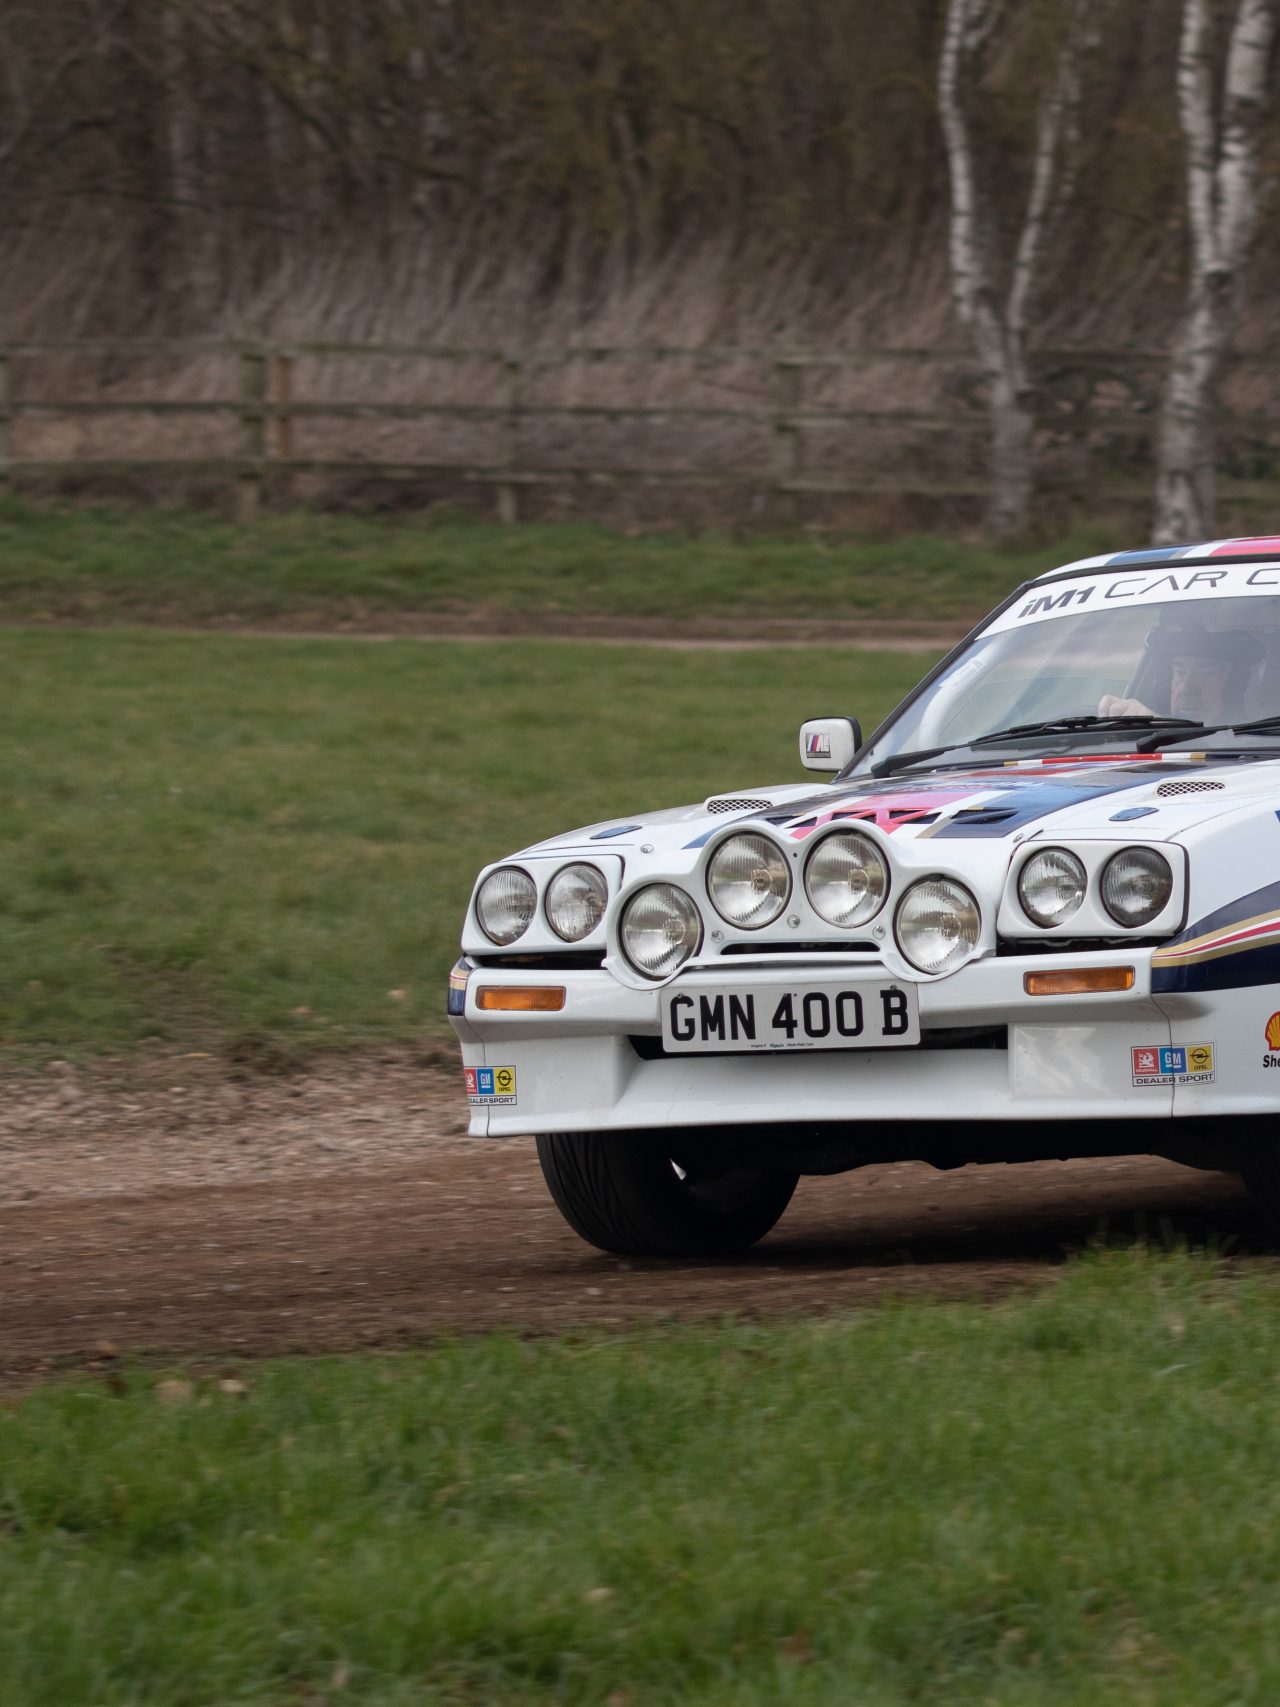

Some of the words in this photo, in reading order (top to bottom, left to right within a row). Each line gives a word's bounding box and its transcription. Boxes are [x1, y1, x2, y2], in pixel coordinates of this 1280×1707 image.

[1104, 570, 1229, 599] CAR
[669, 994, 757, 1042] GMN
[771, 990, 864, 1039] 400
[879, 988, 909, 1036] B
[1164, 1051, 1182, 1065] GM
[1135, 1077, 1175, 1085] DEALER
[1178, 1073, 1214, 1084] SPORT
